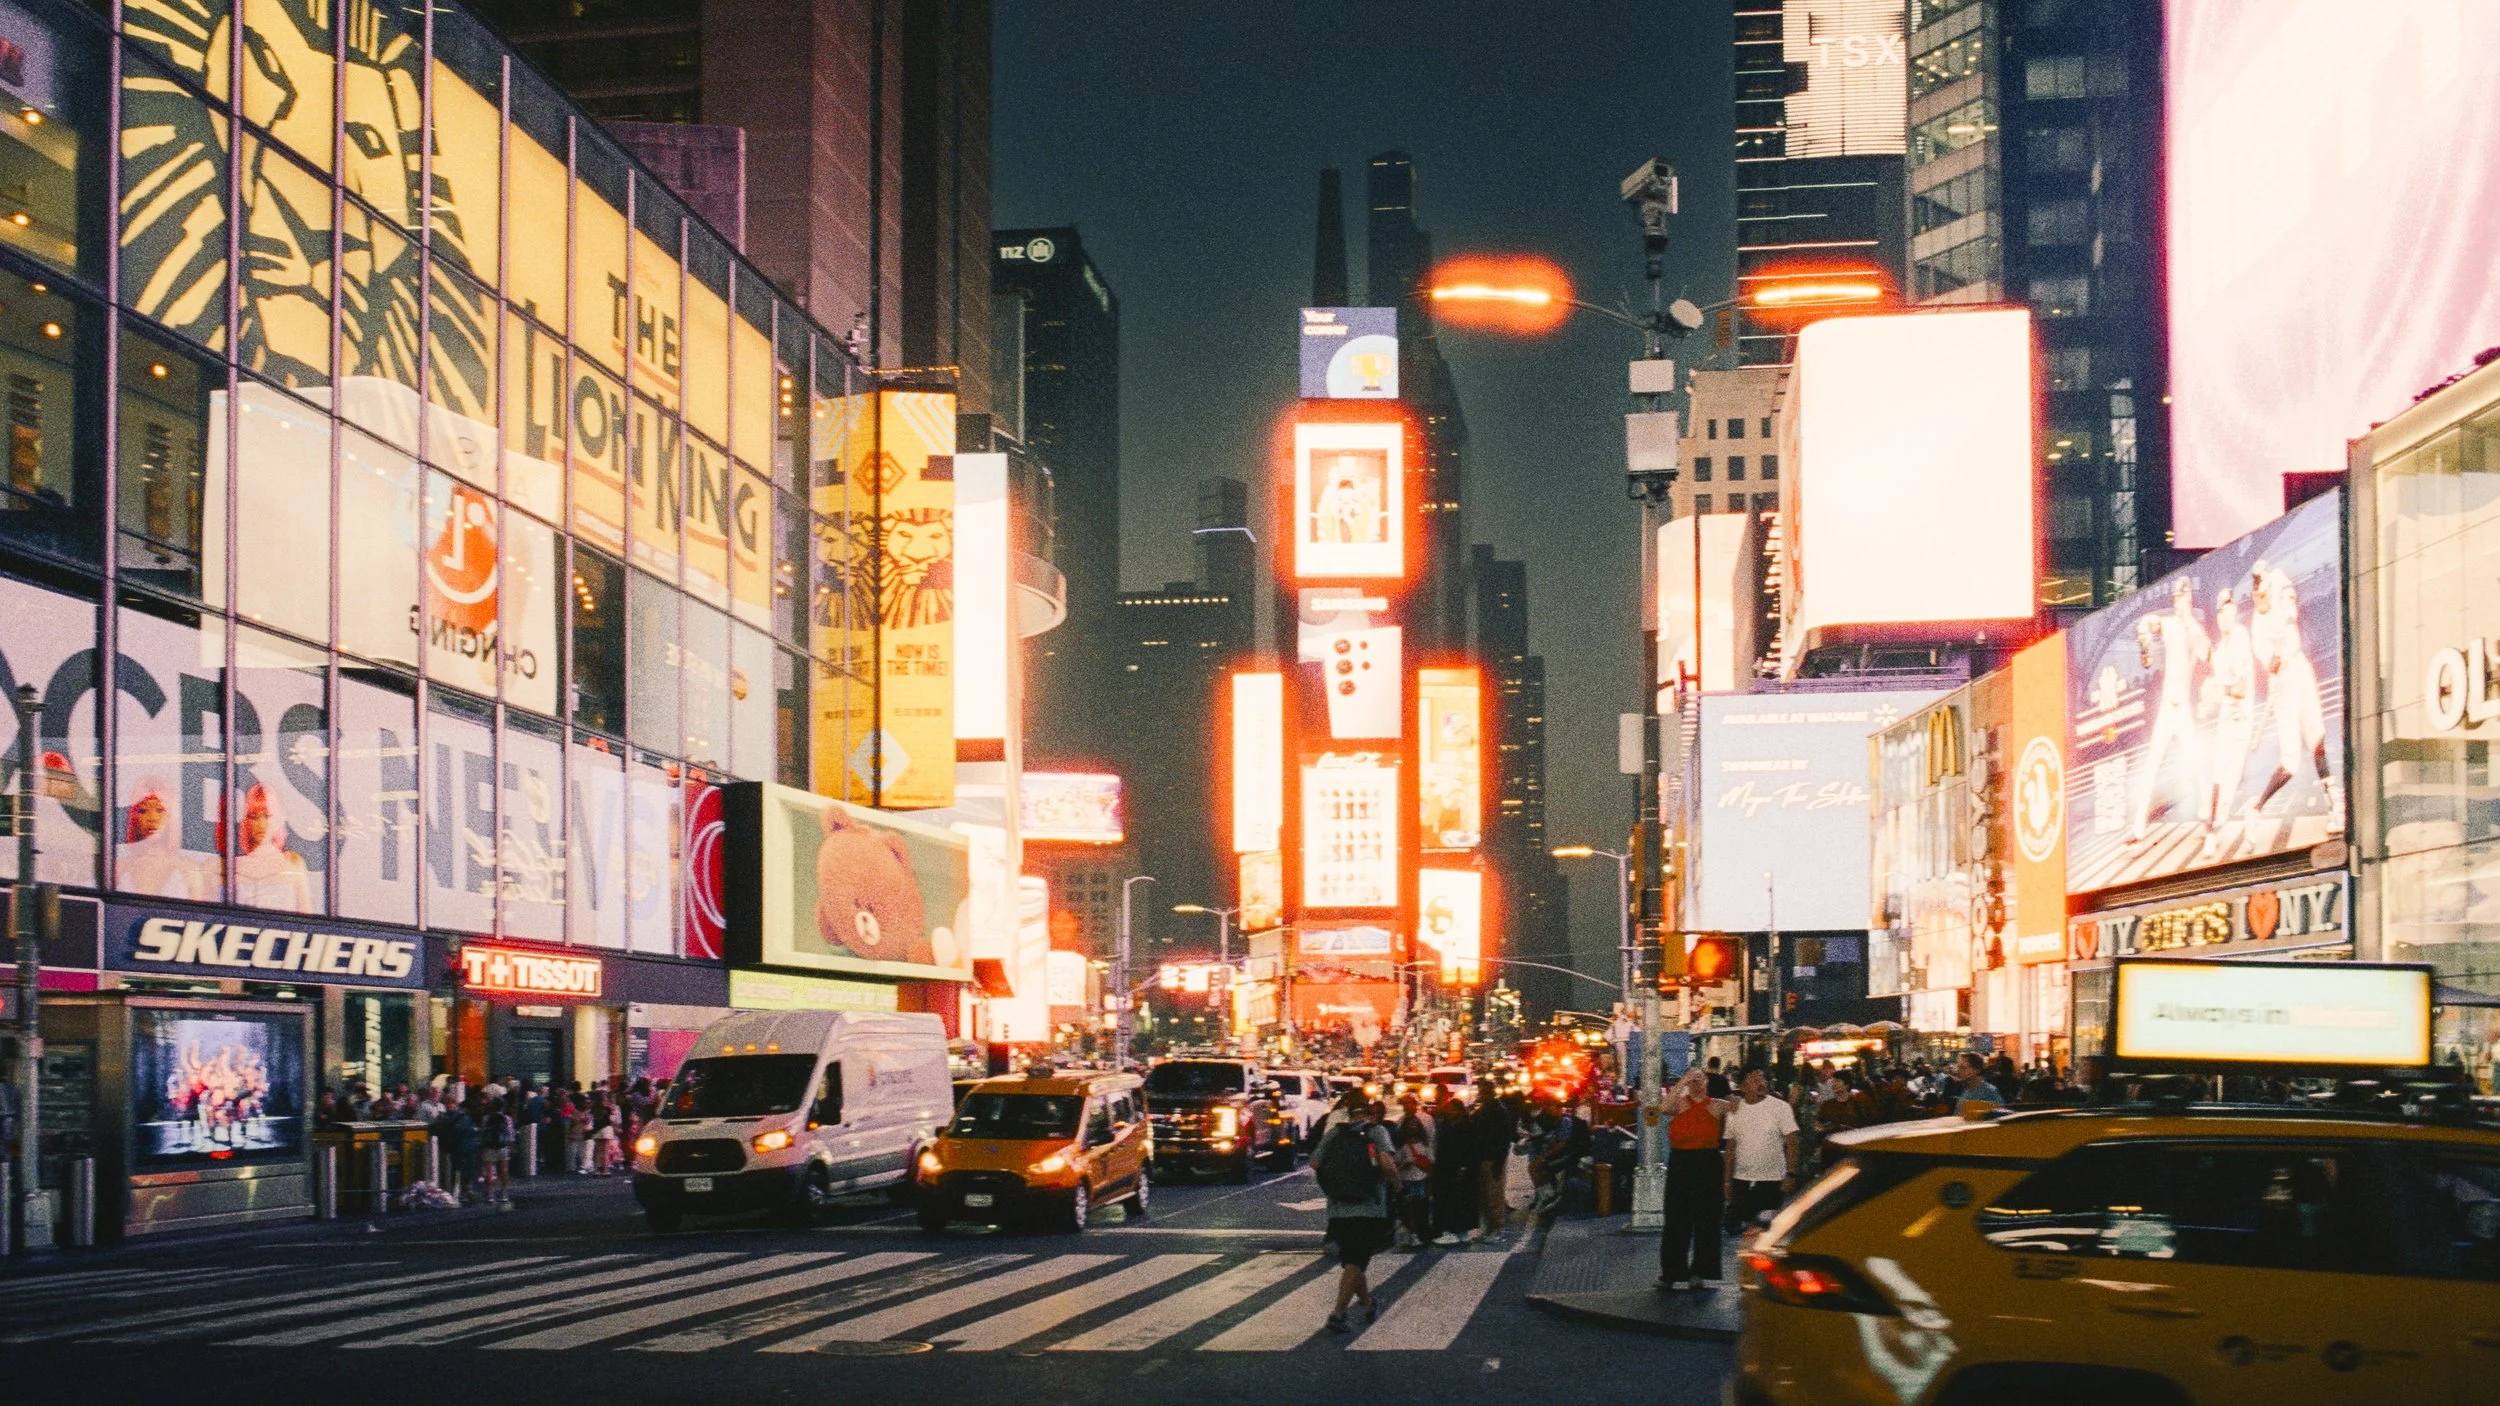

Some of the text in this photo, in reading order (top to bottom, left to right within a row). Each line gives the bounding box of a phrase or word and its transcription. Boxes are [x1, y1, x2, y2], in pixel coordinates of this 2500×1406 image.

[1811, 33, 1901, 68] TSX
[607, 271, 680, 379] THE
[525, 299, 644, 487] LION
[655, 393, 757, 554] KING
[887, 660, 909, 675] THE
[895, 644, 940, 659] NOW IS
[41, 648, 657, 921] CBS NEWS
[134, 917, 416, 978] SKECHERS
[2142, 902, 2230, 951] GIFTS
[514, 956, 599, 993] TISSOT
[2153, 1002, 2256, 1030] Always
[365, 997, 382, 1101] SKECHER
